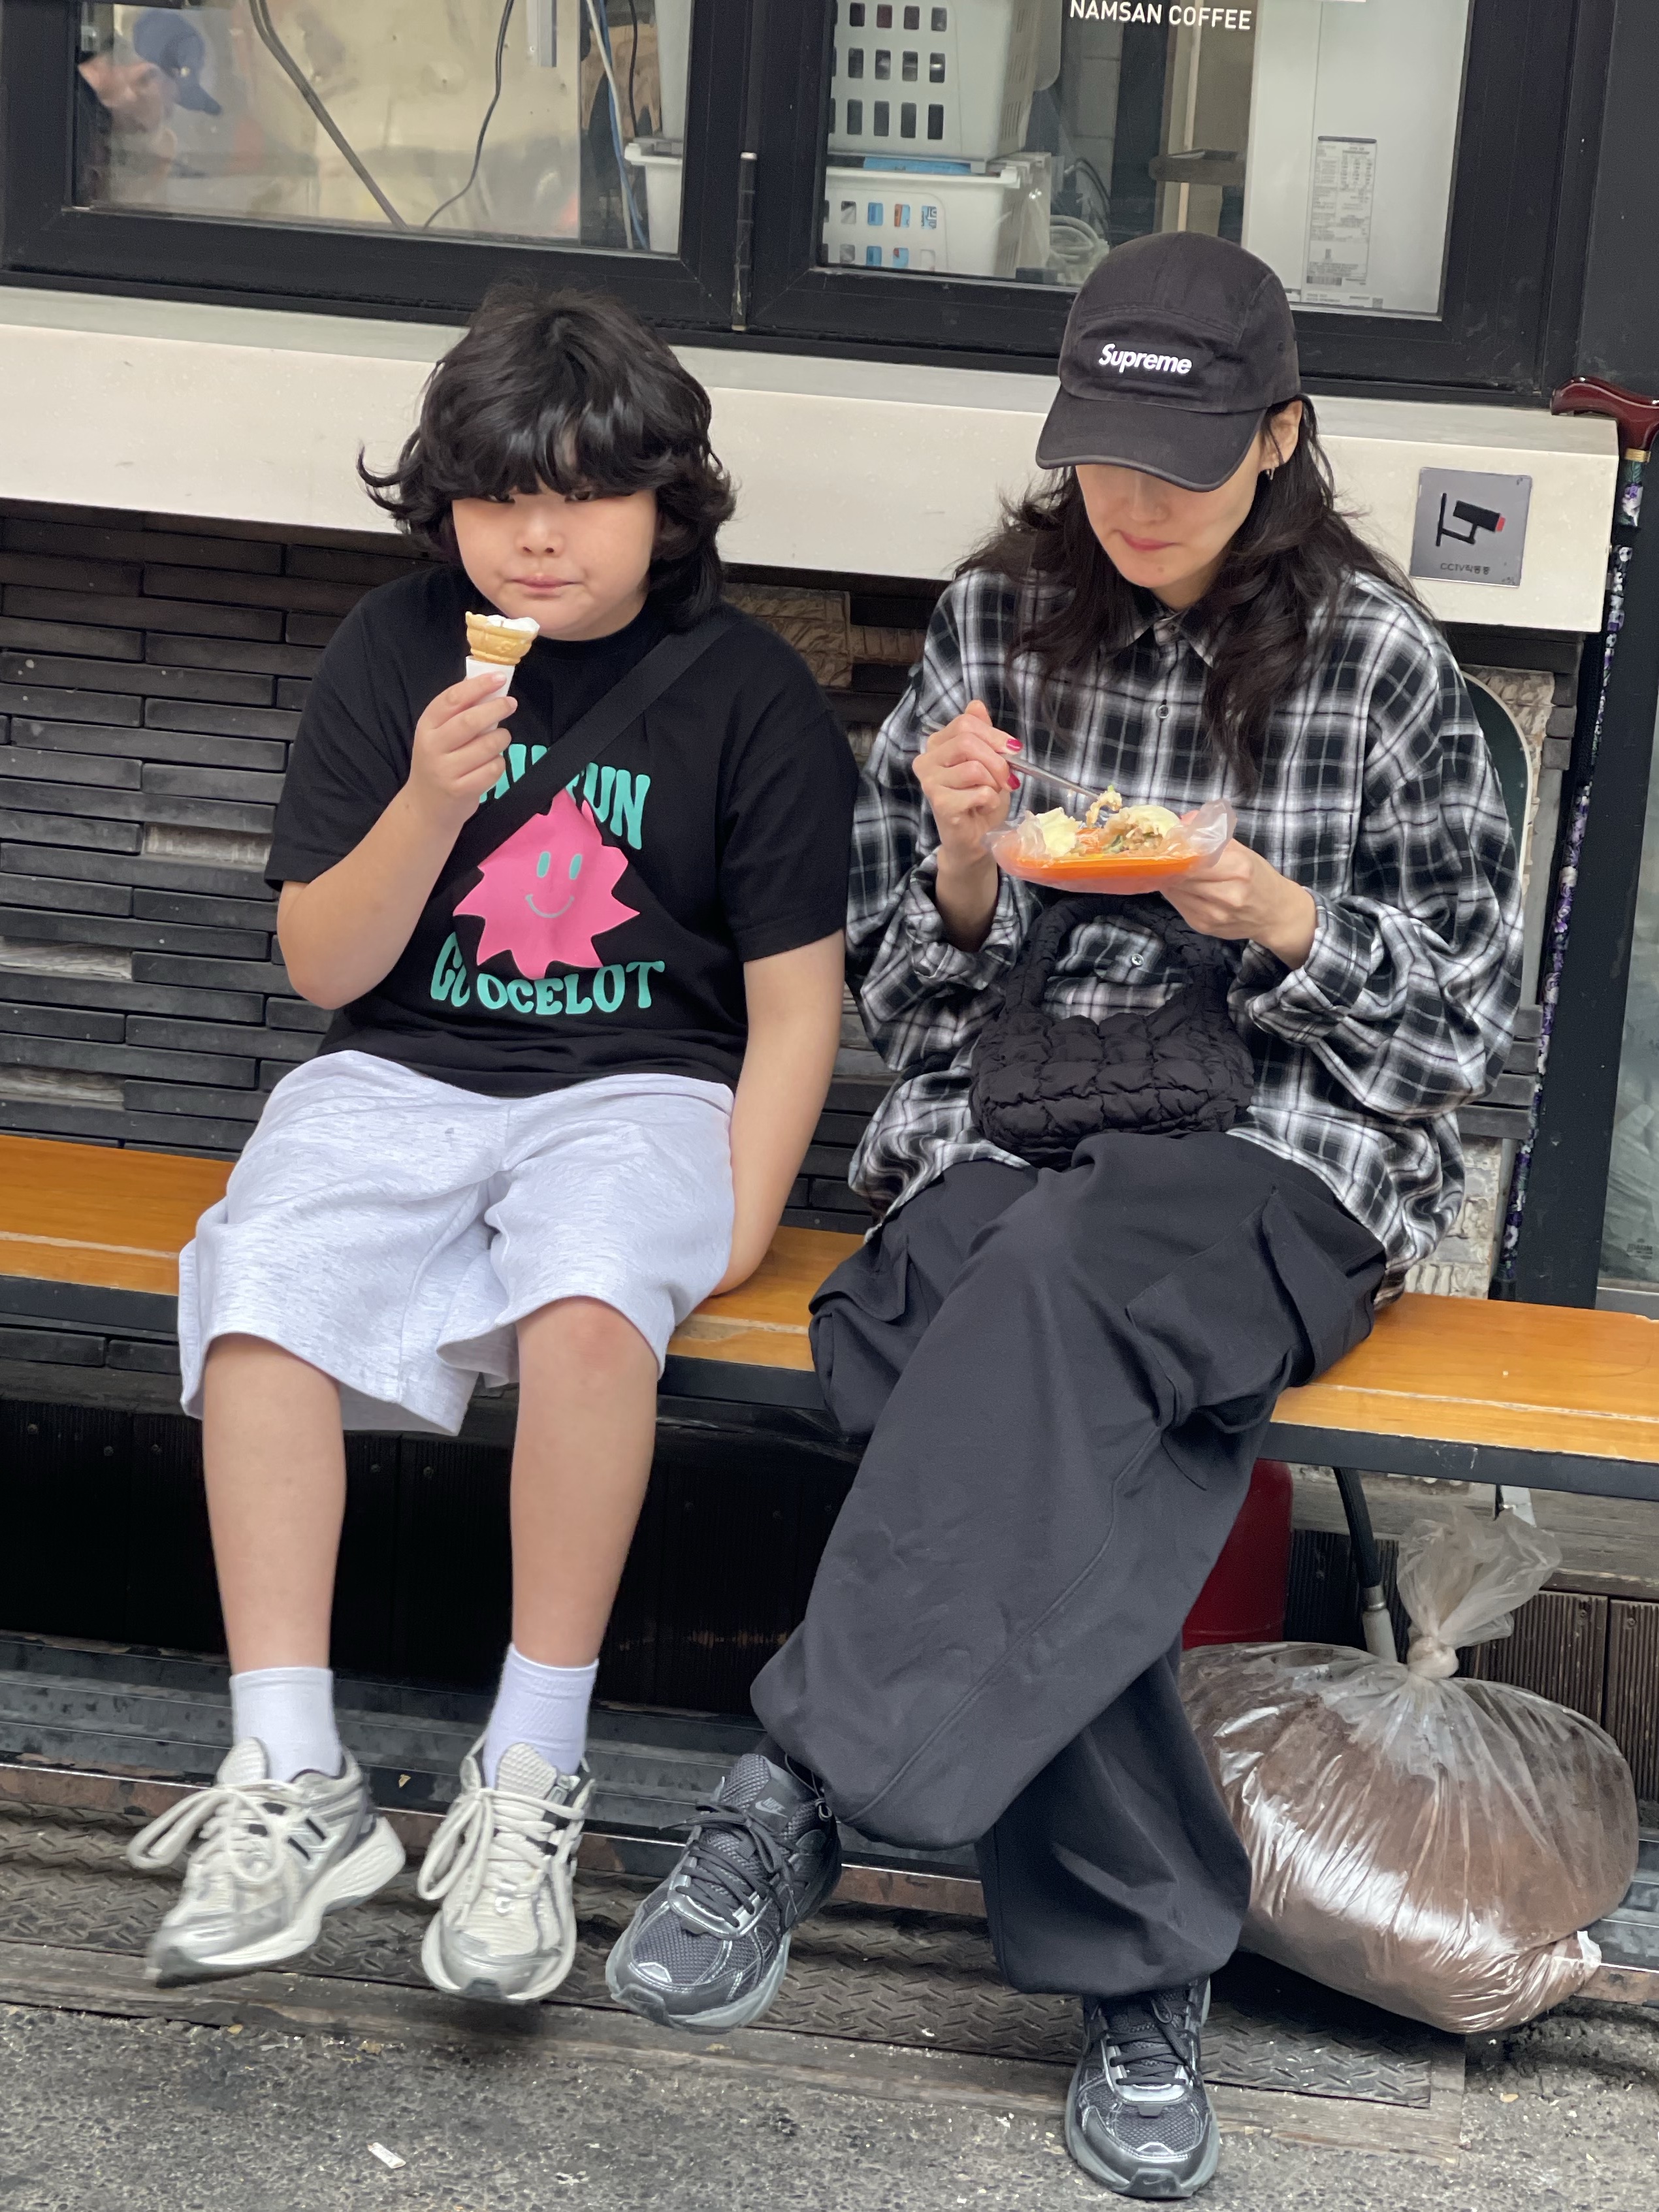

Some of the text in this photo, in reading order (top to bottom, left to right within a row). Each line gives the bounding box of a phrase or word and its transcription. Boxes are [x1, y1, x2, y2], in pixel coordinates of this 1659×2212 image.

[1070, 0, 1252, 30] NAMSAN COFFEE
[1099, 343, 1192, 374] Supreme
